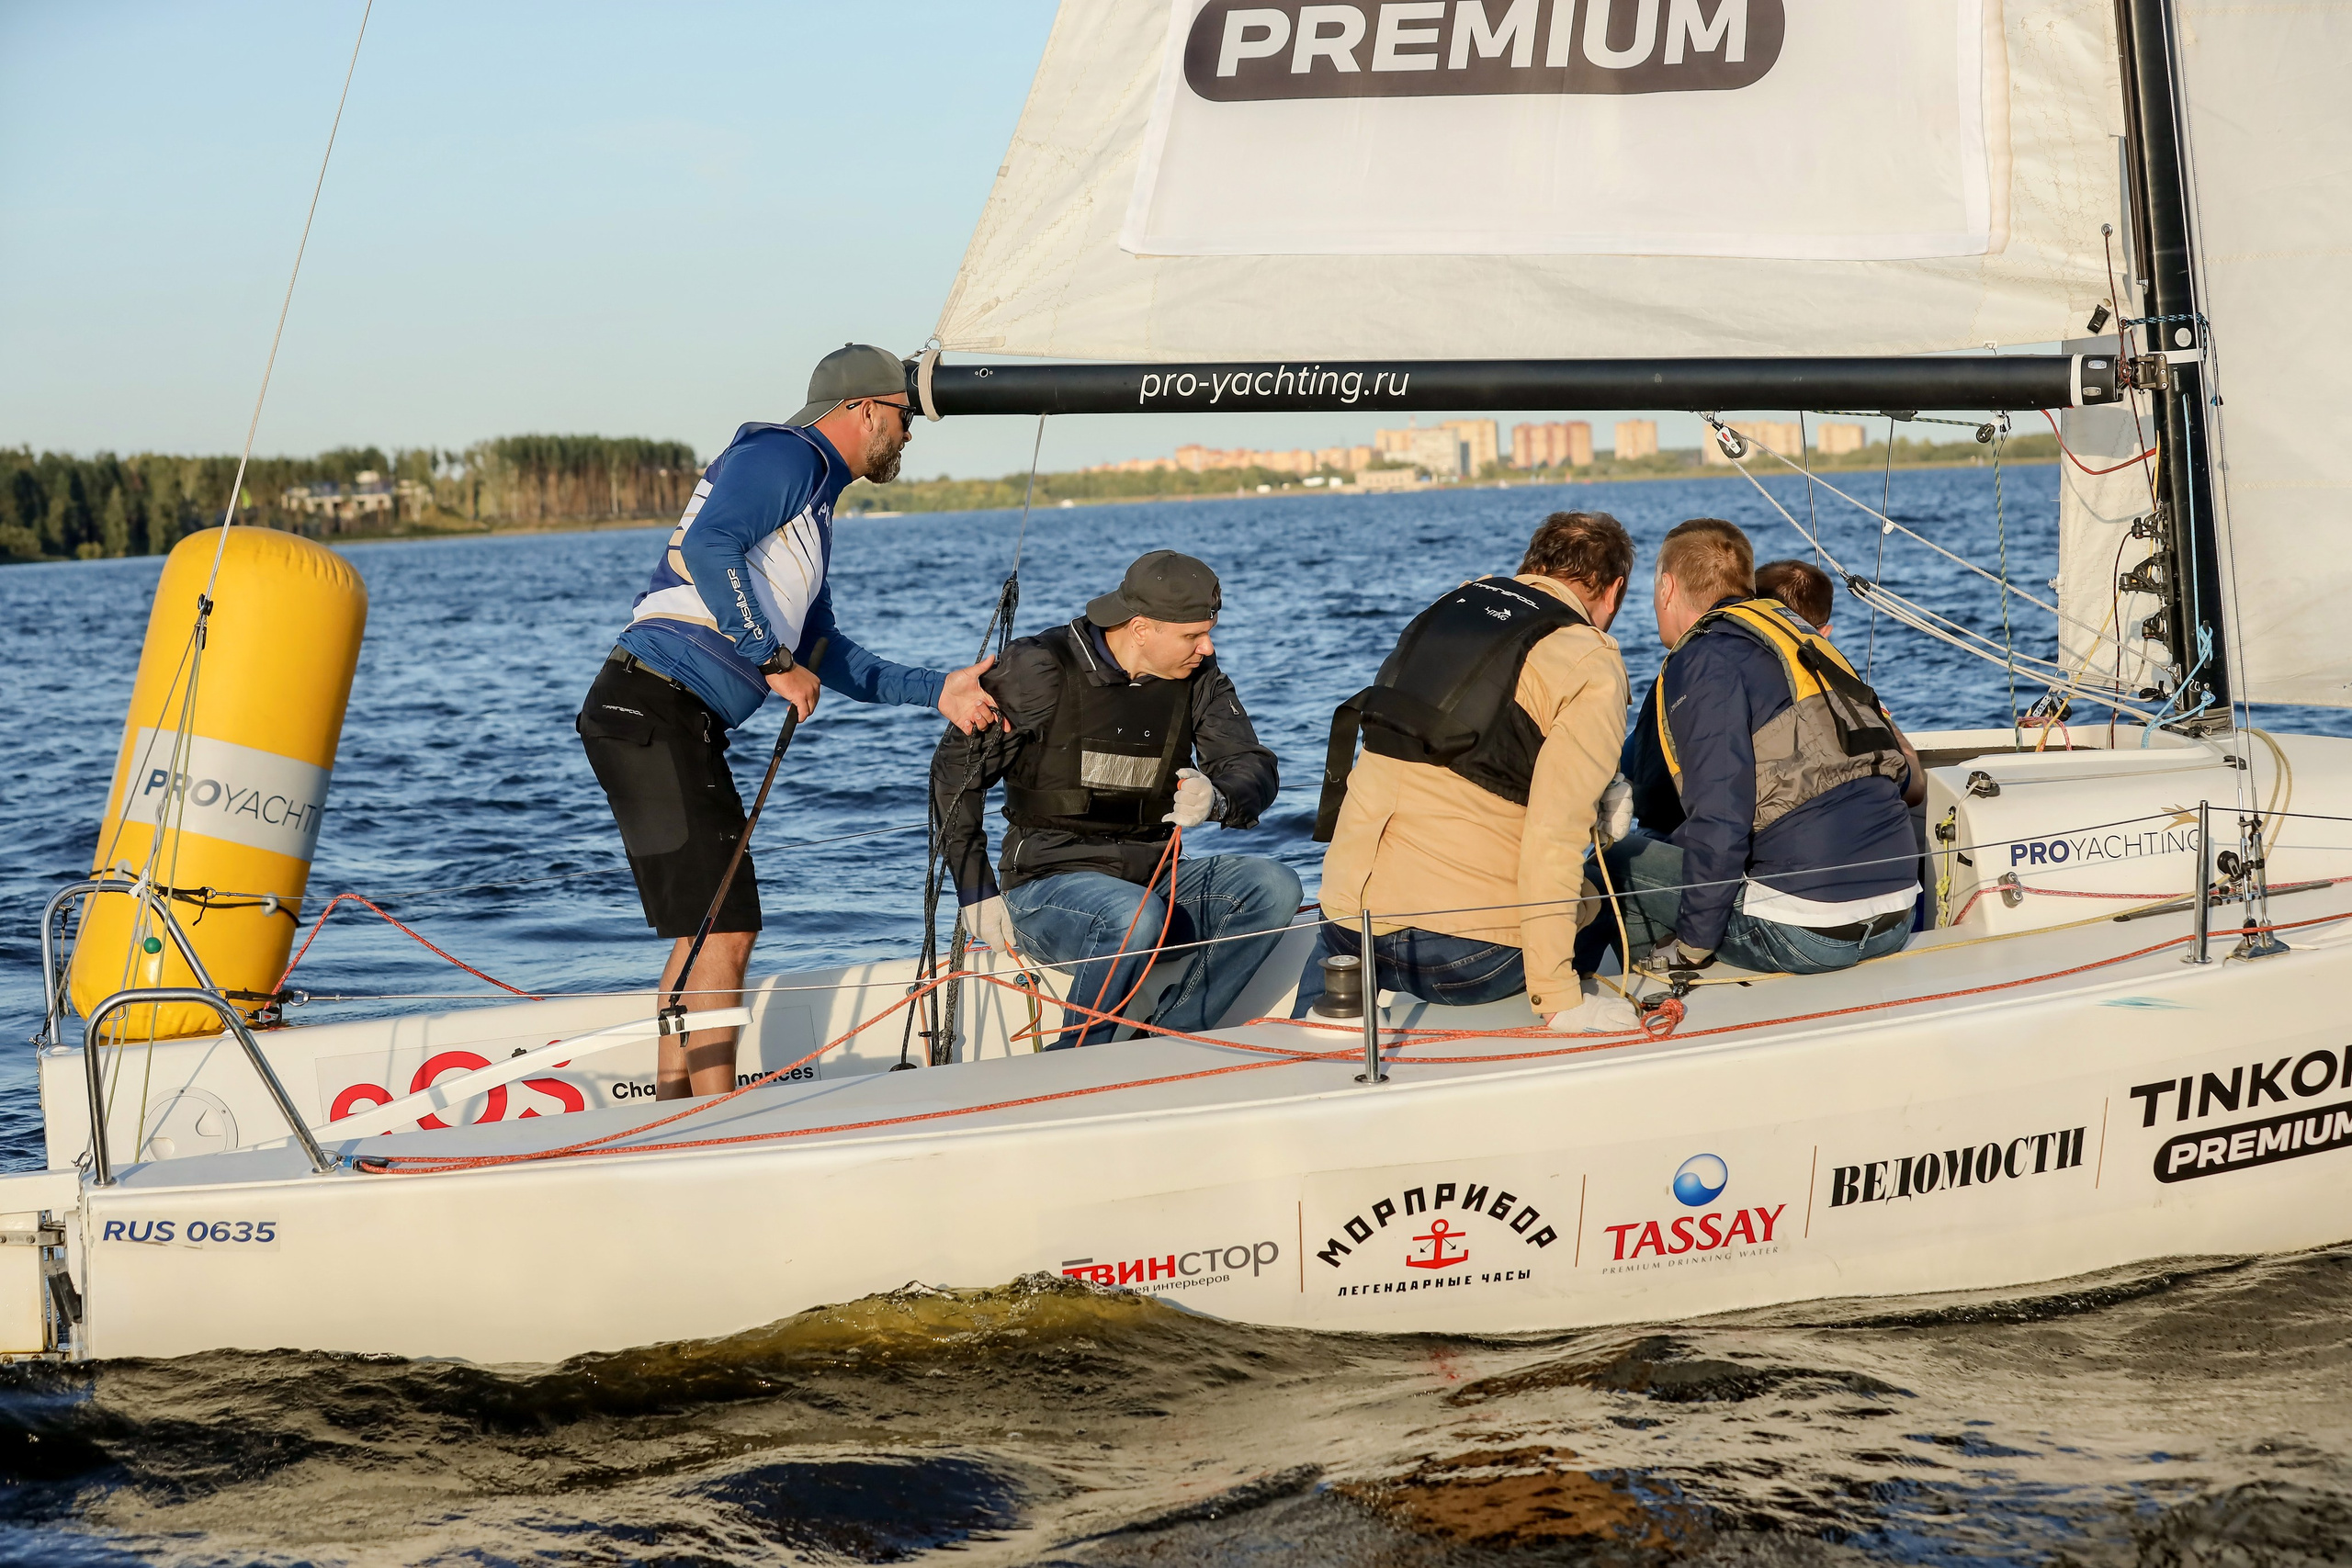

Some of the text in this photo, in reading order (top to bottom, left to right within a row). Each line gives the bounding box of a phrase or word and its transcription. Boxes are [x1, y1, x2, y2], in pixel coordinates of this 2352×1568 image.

[1216, 0, 1747, 78] PREMIUM
[1139, 365, 1410, 404] pro-yachting.ru
[1828, 1126, 2087, 1205] ВЕДОМОСТИ
[102, 1220, 277, 1243] RUS 0635
[1317, 1182, 1558, 1269] МОРПРИБОР
[1603, 1202, 1789, 1261] TASSAY
[1602, 1246, 1780, 1275] PREMIUM DRINKING WATER
[1153, 1273, 1231, 1292] интерьеров
[1338, 1269, 1532, 1297] ЛЕГЕНДАРНЫЕ ЧАСЫ
